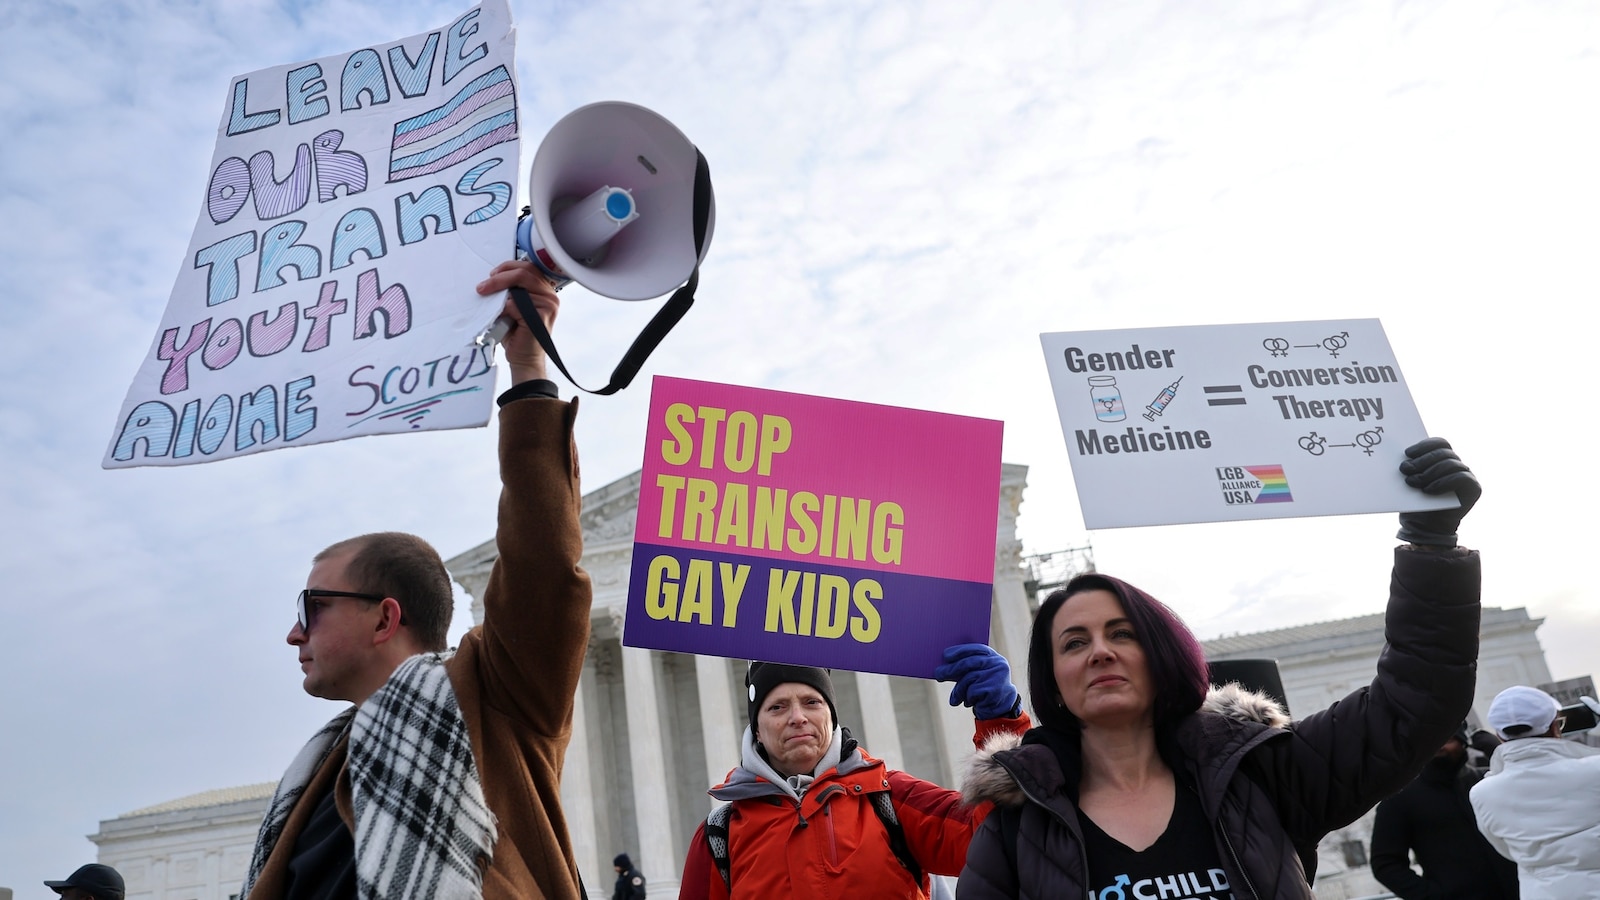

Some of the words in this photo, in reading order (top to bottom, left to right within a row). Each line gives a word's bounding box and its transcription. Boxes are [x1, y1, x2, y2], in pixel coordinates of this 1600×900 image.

[227, 8, 488, 136] LEAVE
[208, 129, 368, 225] OUR
[1064, 344, 1175, 373] Gender
[1247, 361, 1398, 389] Conversion
[1272, 395, 1385, 422] Therapy
[661, 403, 793, 476] STOP
[1075, 426, 1212, 456] Medicine
[1216, 467, 1245, 481] LGB
[1222, 480, 1262, 490] ALLIANCE
[1224, 490, 1254, 504] USA
[656, 474, 905, 565] TRANSING
[644, 555, 752, 628] GAY
[764, 568, 884, 643] KIDS
[1132, 868, 1231, 900] CHILD
